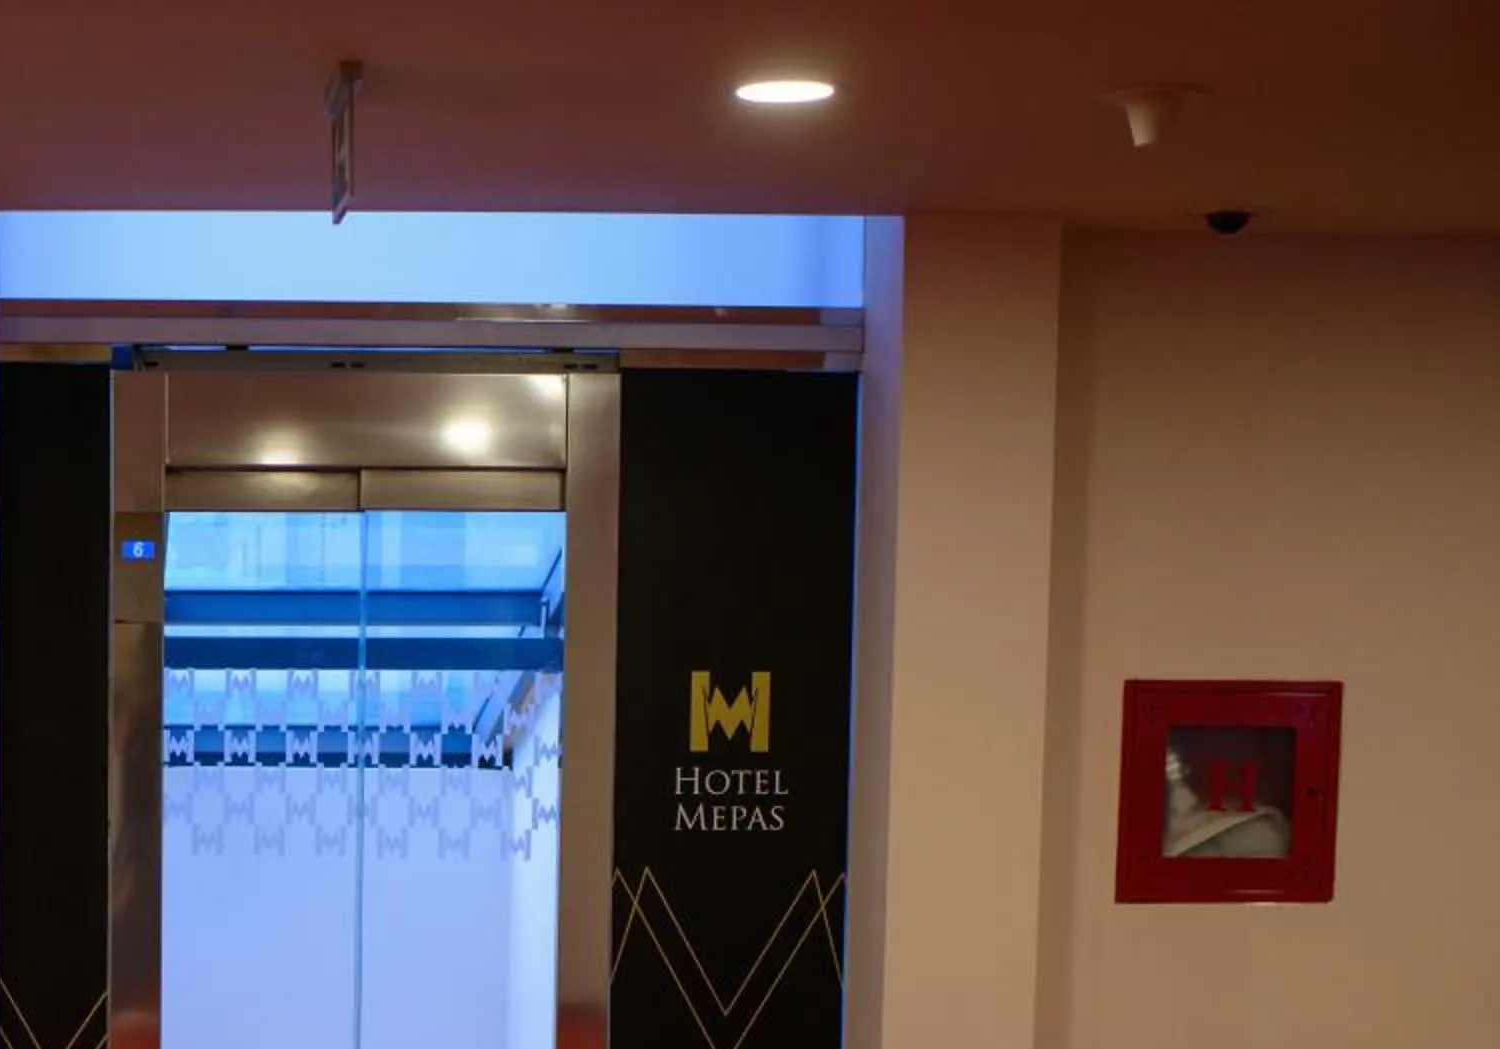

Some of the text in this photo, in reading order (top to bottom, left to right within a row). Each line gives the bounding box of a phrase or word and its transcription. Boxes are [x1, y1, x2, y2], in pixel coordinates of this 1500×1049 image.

[132, 540, 145, 559] 6
[674, 766, 789, 796] HOTEL
[674, 803, 786, 832] MEPAS
